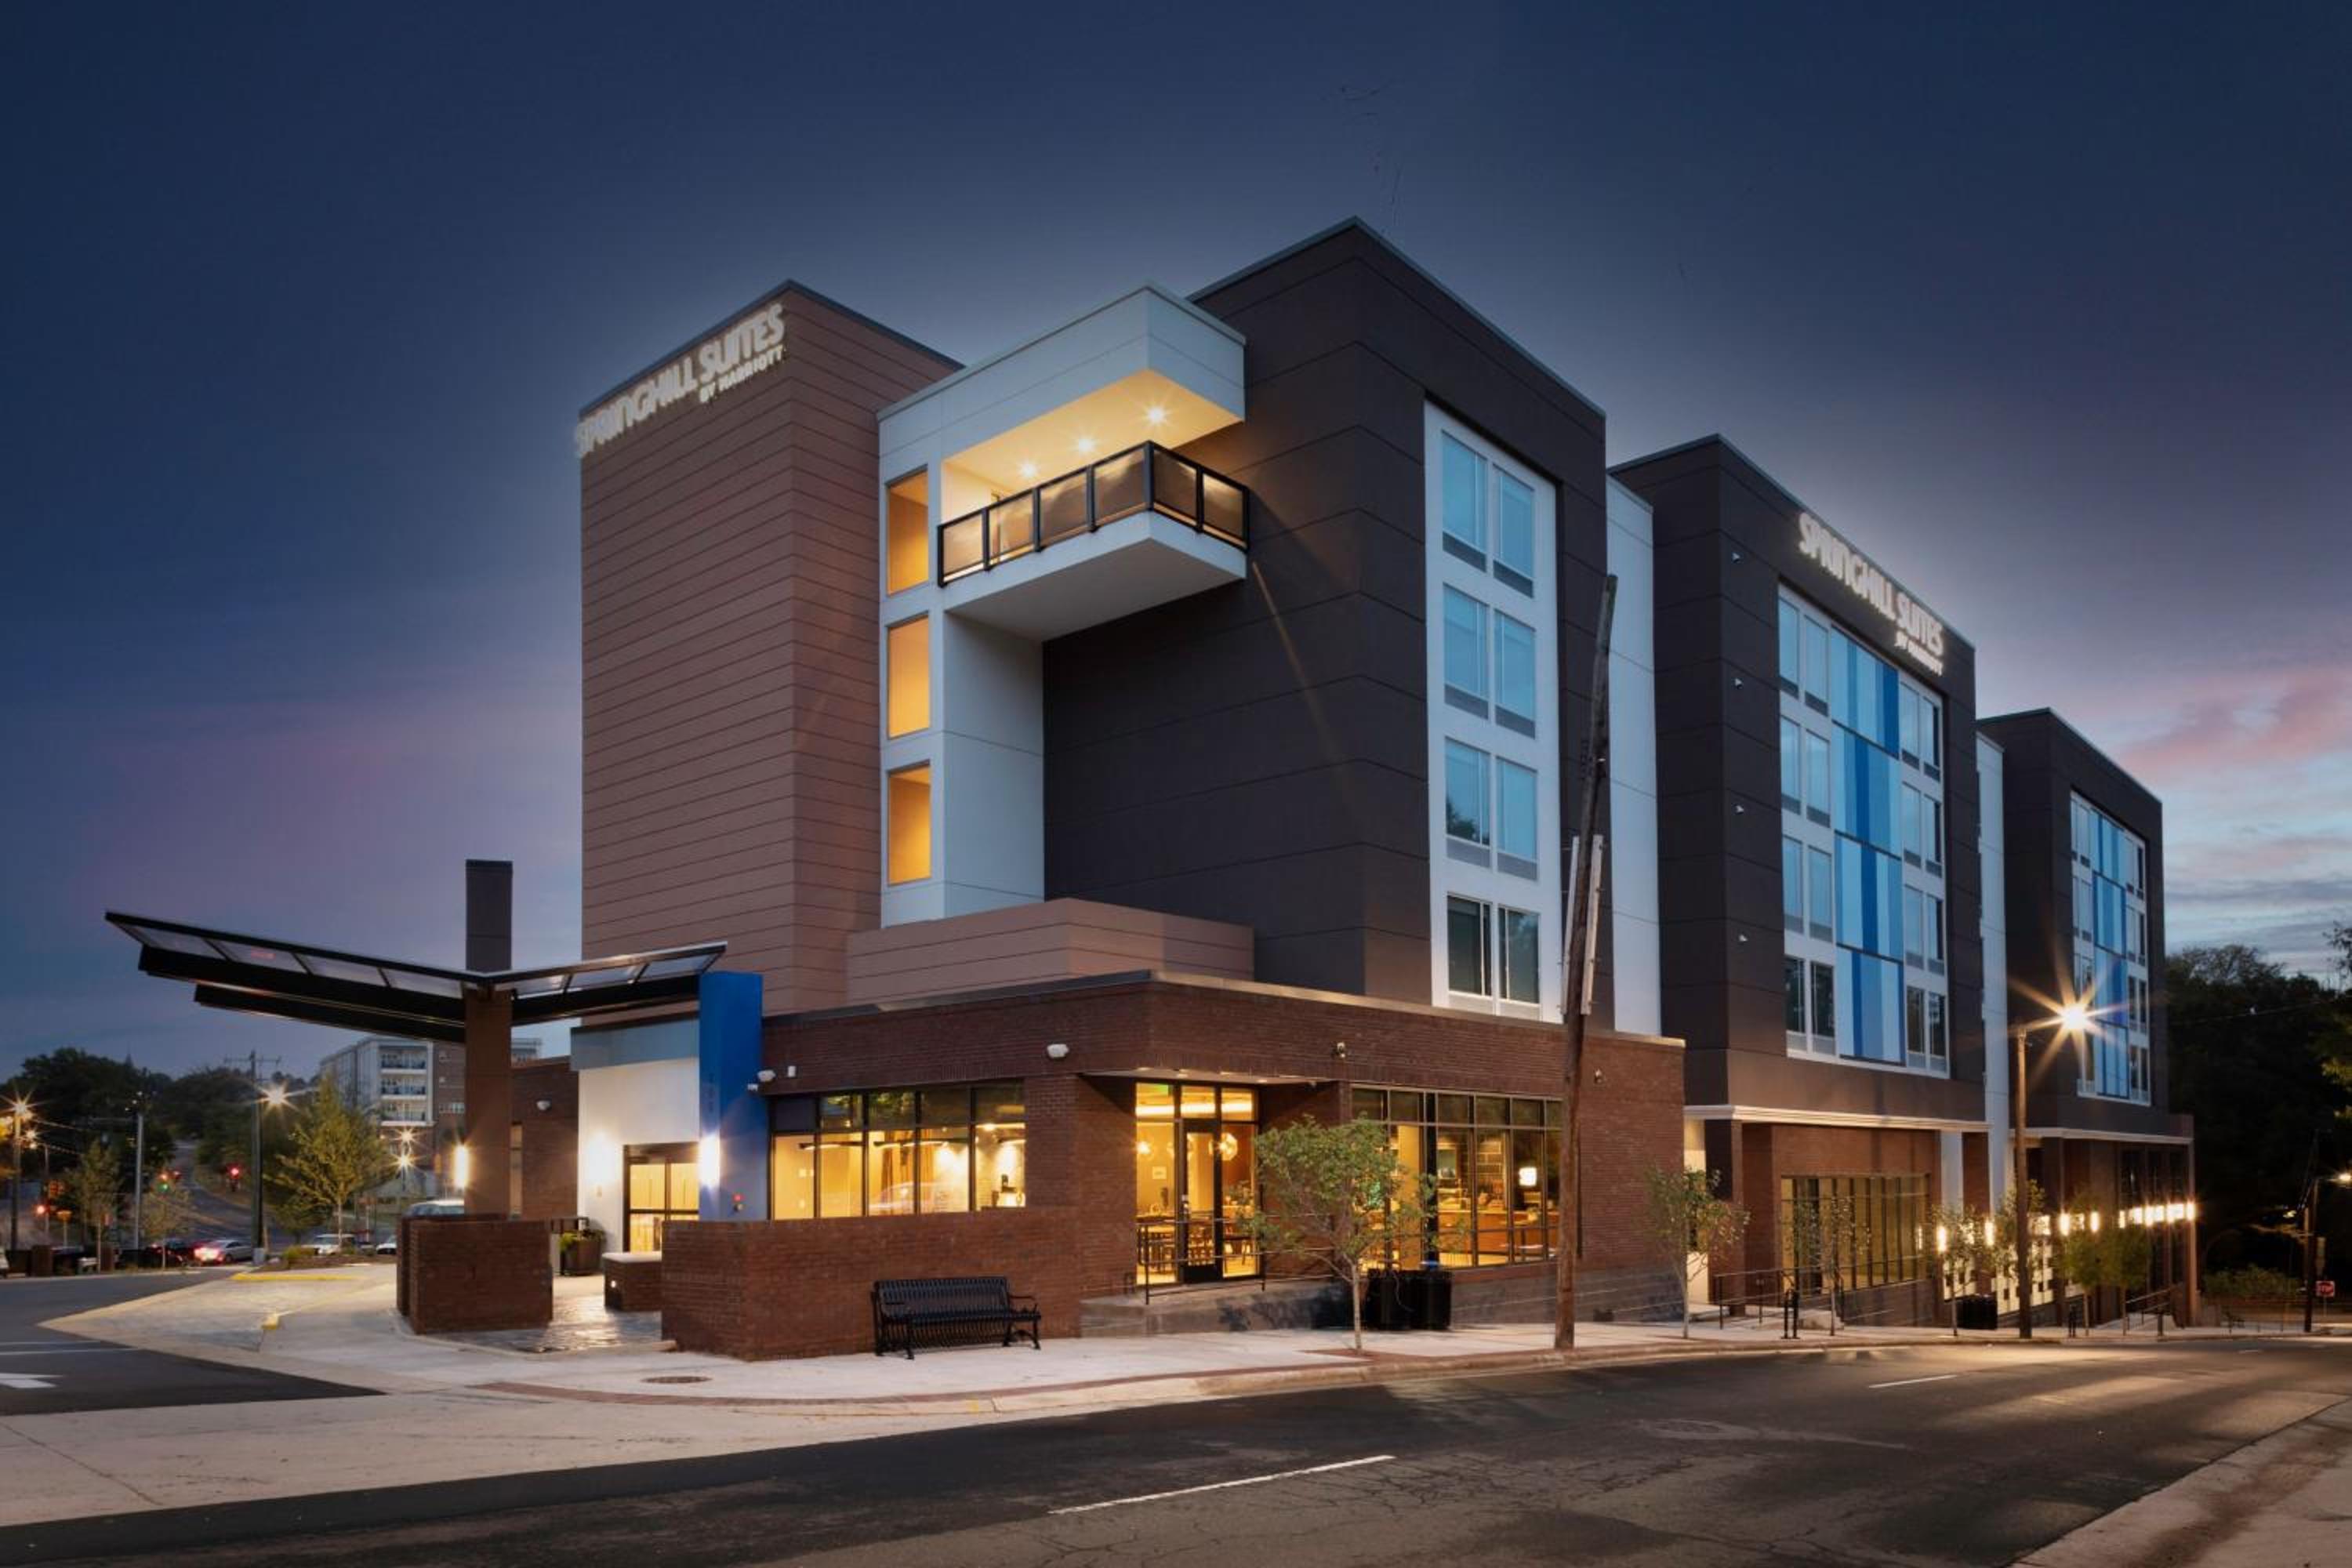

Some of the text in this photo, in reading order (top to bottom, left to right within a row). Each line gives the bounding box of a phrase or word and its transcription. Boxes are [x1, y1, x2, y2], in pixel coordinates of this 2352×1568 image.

[699, 303, 785, 383] SUITES
[699, 381, 716, 403] BY
[1896, 592, 1944, 655] SUITES
